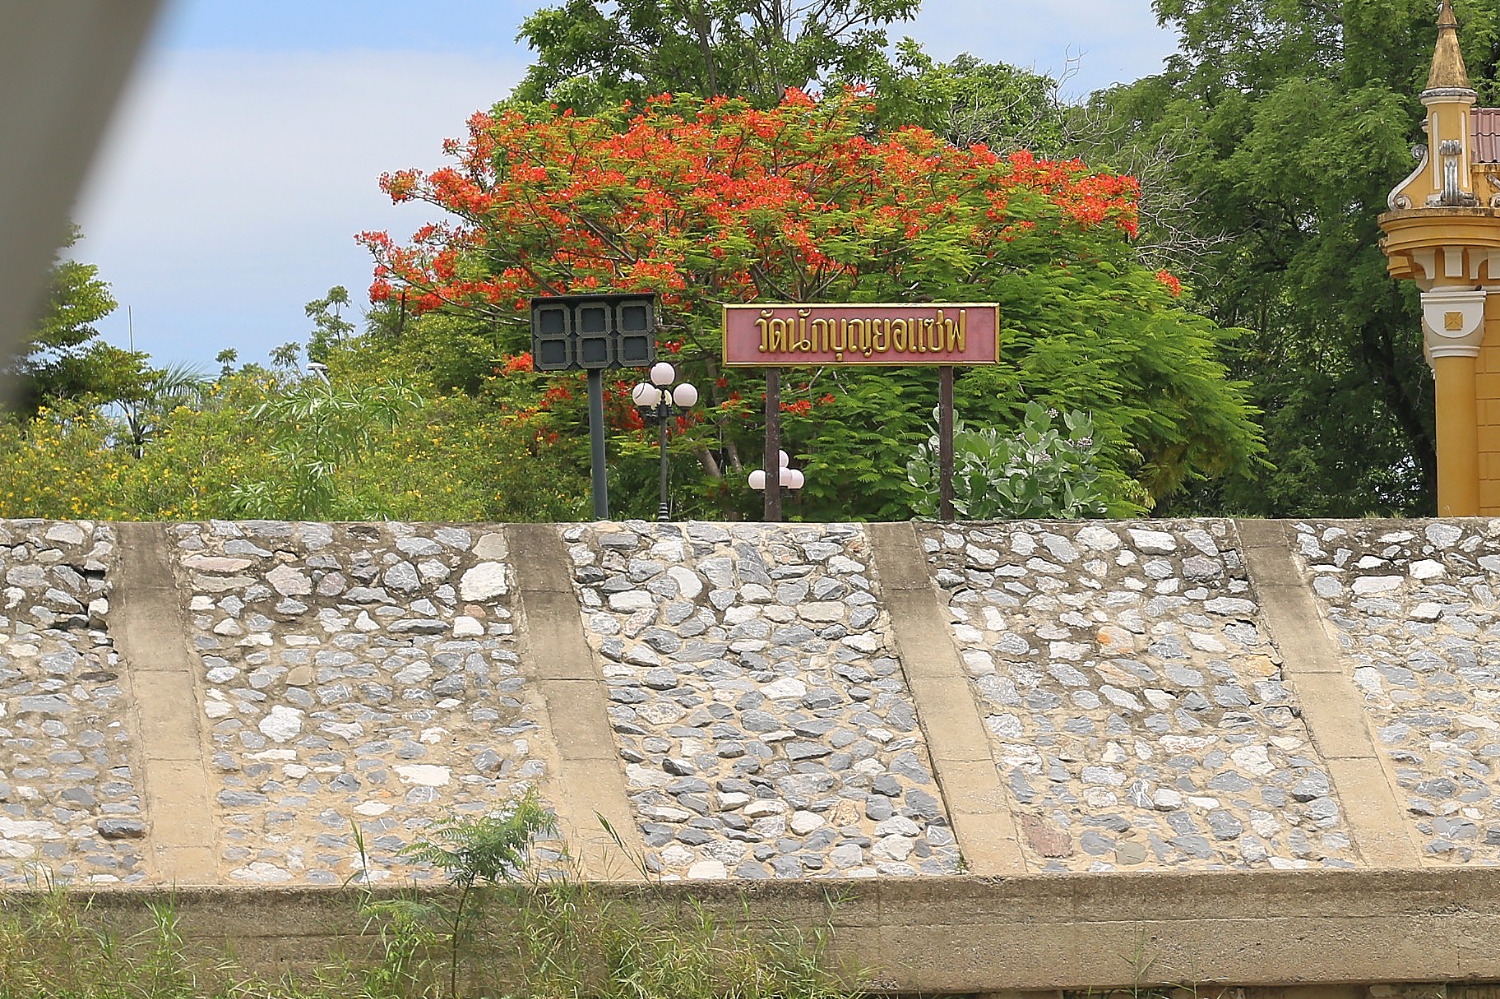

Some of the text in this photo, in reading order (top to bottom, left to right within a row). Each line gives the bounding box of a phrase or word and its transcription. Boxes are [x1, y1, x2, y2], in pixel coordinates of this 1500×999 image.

[755, 308, 967, 360] วัดนักบุญยอแซฟ
